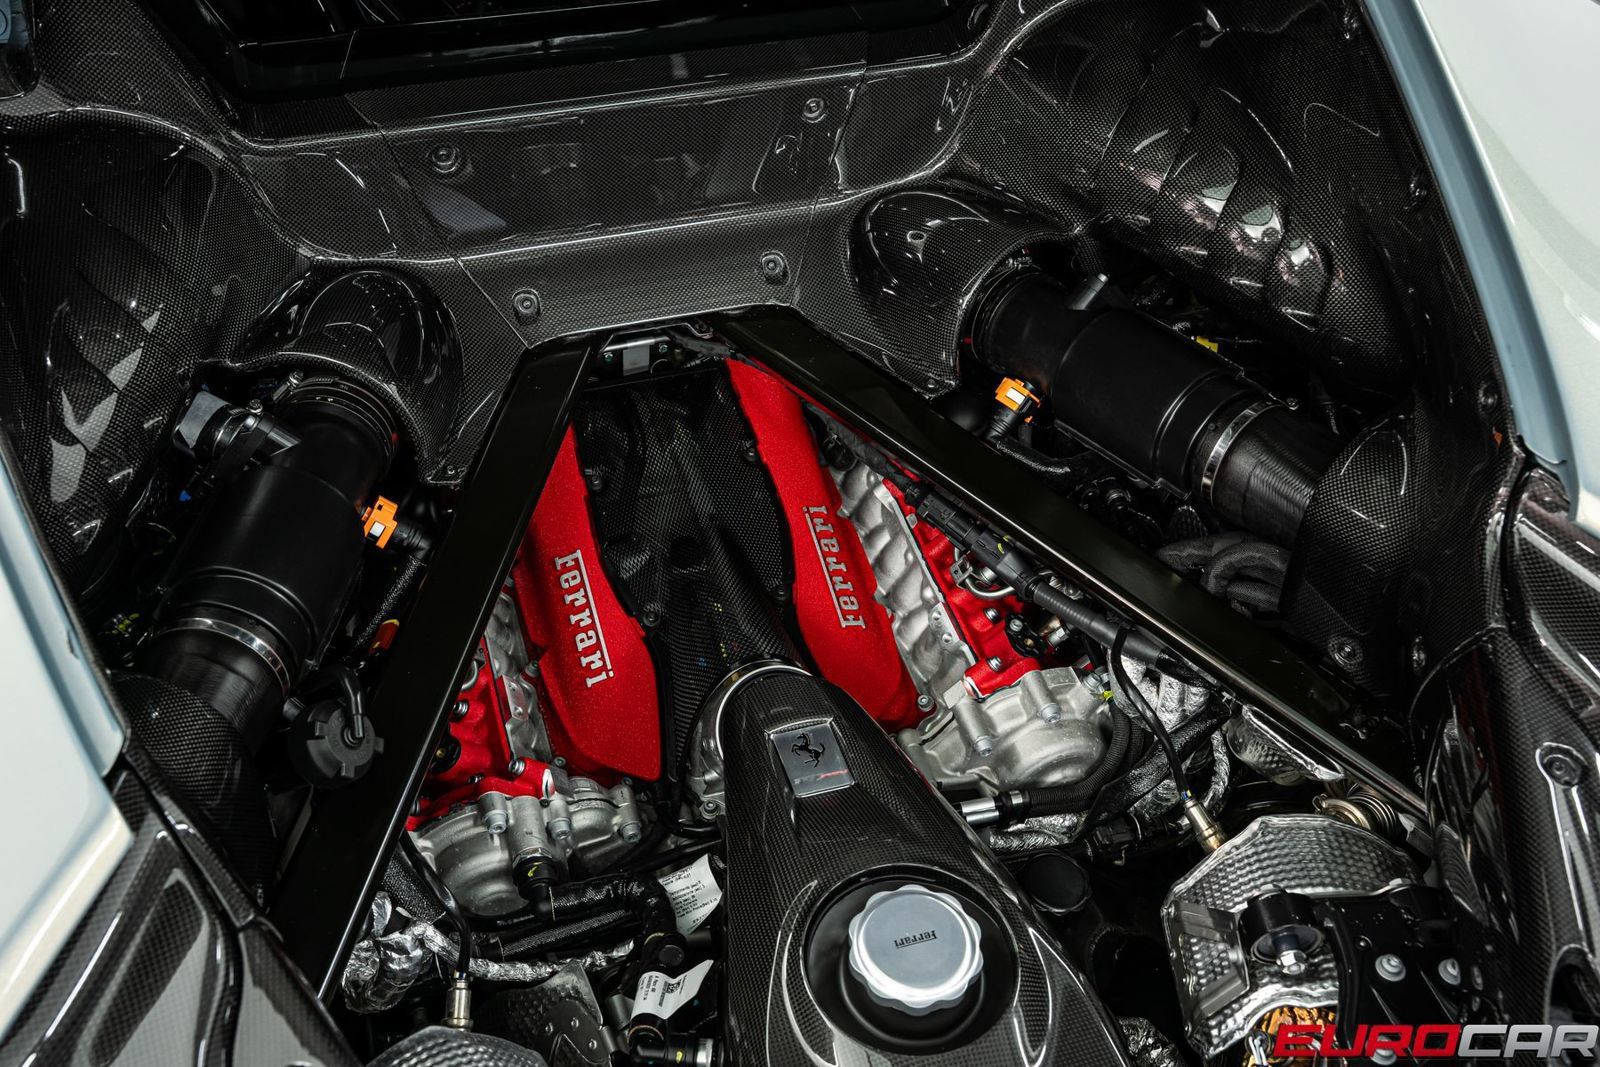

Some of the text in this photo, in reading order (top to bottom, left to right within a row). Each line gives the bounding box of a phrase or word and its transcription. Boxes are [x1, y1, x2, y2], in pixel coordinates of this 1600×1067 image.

[554, 549, 615, 688] Ferrari
[803, 505, 866, 629] Ferrari
[894, 930, 938, 949] Ferrari
